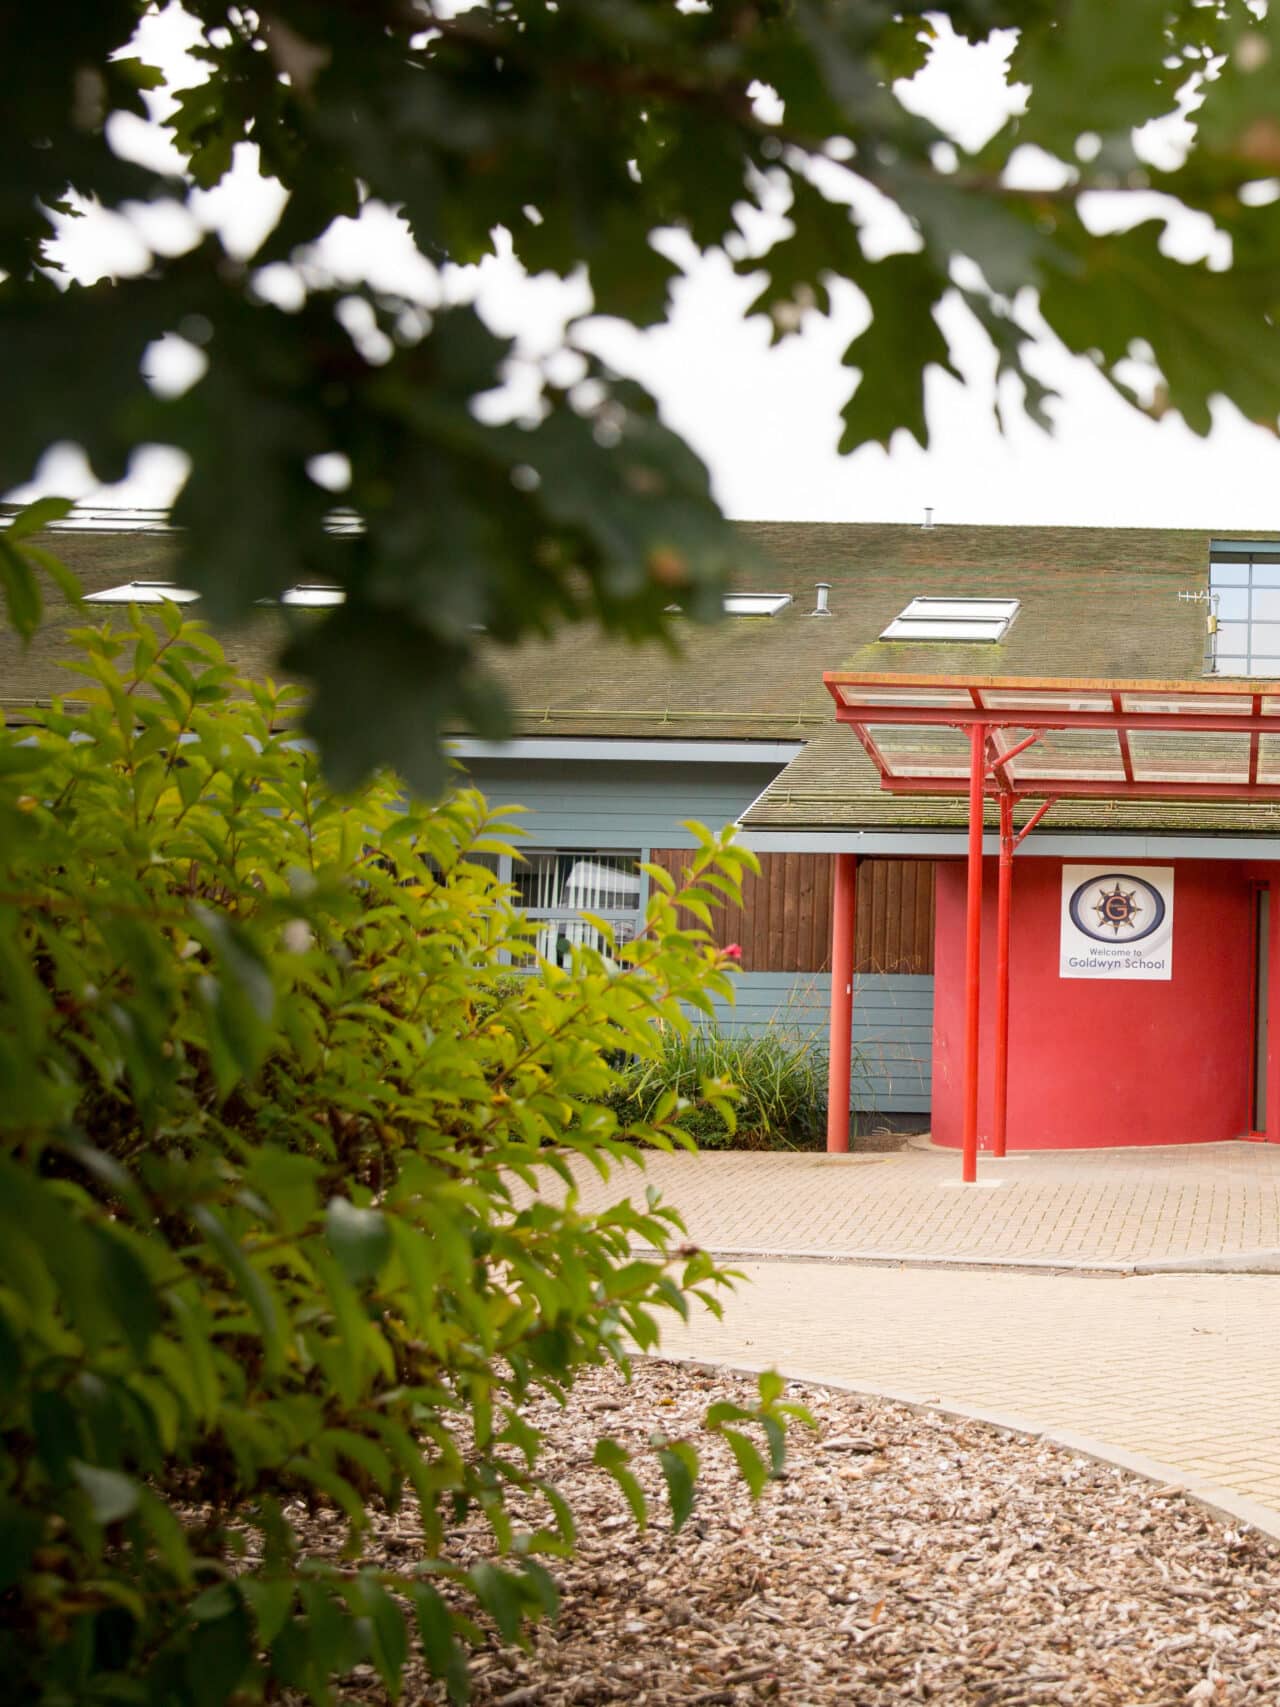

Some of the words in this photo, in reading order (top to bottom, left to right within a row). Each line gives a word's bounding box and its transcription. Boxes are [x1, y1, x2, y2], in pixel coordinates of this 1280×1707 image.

[1106, 896, 1128, 920] G
[1089, 947, 1131, 957] Welcome
[1133, 949, 1142, 957] to
[1068, 957, 1121, 970] Goldwyn
[1124, 958, 1165, 969] School
